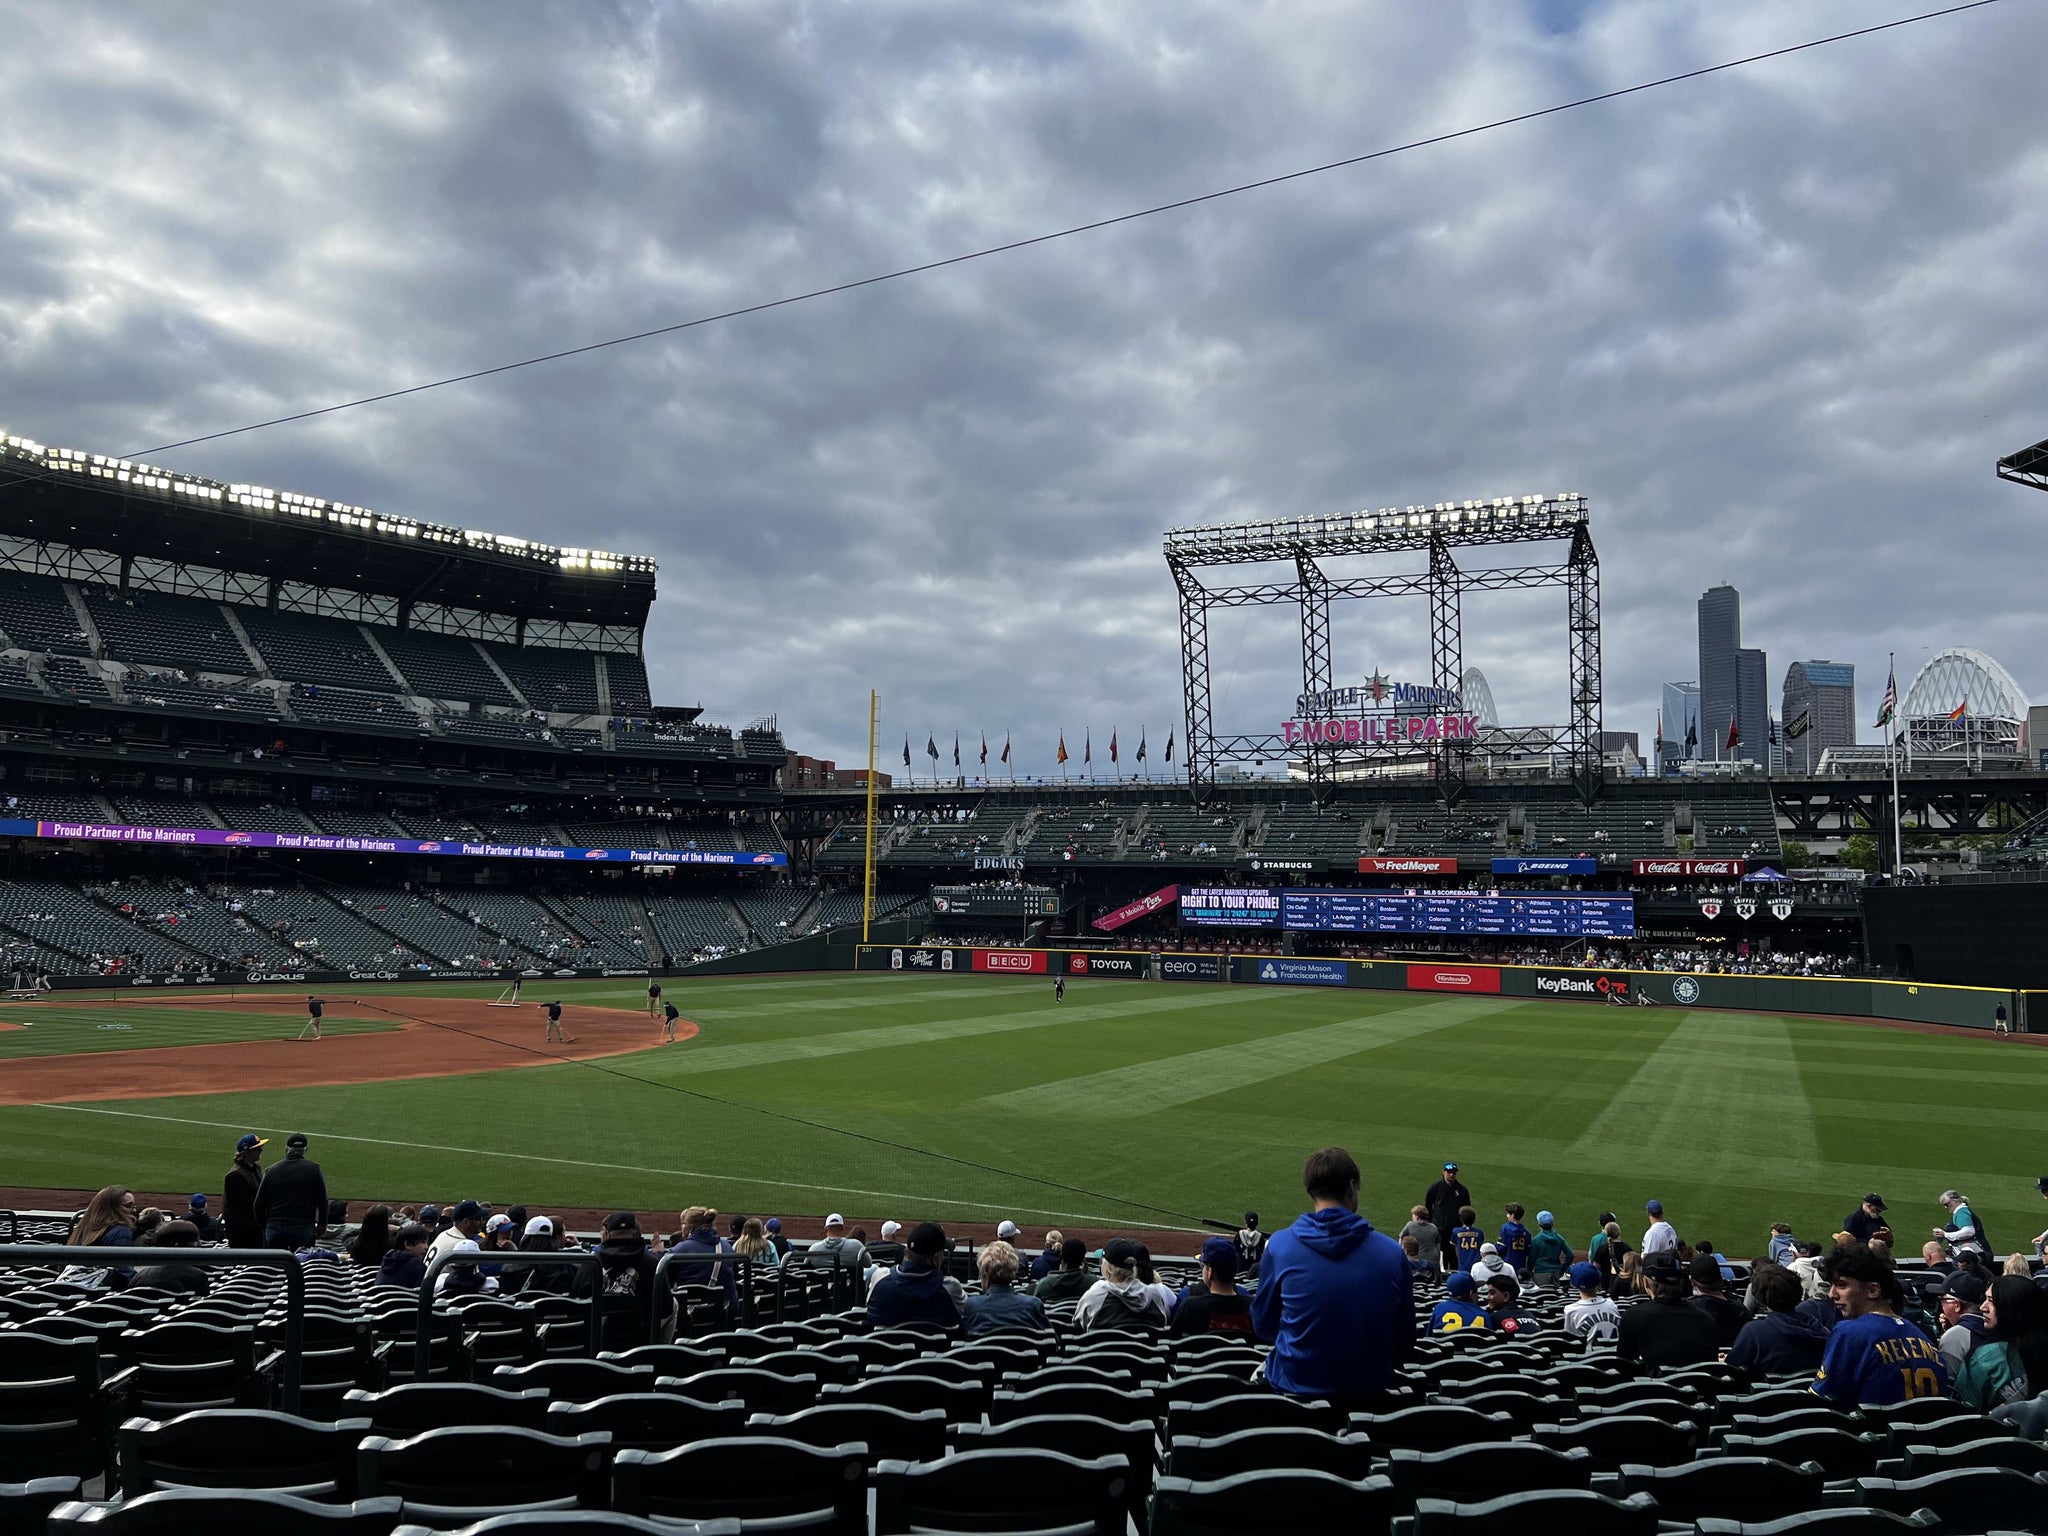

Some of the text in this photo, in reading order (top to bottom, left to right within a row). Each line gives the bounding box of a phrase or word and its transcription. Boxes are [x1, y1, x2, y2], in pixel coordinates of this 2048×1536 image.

[1296, 681, 1463, 714] SEATTLE MARINERS
[1281, 715, 1480, 743] T-MOBILE PARK
[54, 824, 196, 842] Proud Partner of the Mariners
[276, 835, 396, 850] Proud Partner of the Mariners
[462, 844, 564, 858] Proud Partner of the Mariners
[630, 851, 734, 862] Proud Partner of the Mariners
[1648, 862, 1682, 873] Coca-Cola
[1695, 862, 1729, 873] Coca-Cola
[1182, 896, 1279, 909] RIGHT TO YOUR PHONE!
[1126, 905, 1144, 917] Mobile
[1705, 905, 1717, 914] 42
[1740, 906, 1752, 914] 24
[1777, 906, 1786, 915] 11
[991, 956, 1029, 966] BECU
[1091, 959, 1132, 970] TOYOTA
[1164, 962, 1196, 972] eero
[1280, 964, 1306, 972] Virginia
[377, 970, 399, 980] Clips
[1537, 978, 1595, 993] KeyBank
[1461, 1238, 1478, 1250] 44
[1512, 1238, 1525, 1250] 29
[1242, 1248, 1257, 1260] 44
[1901, 1367, 1940, 1400] 10
